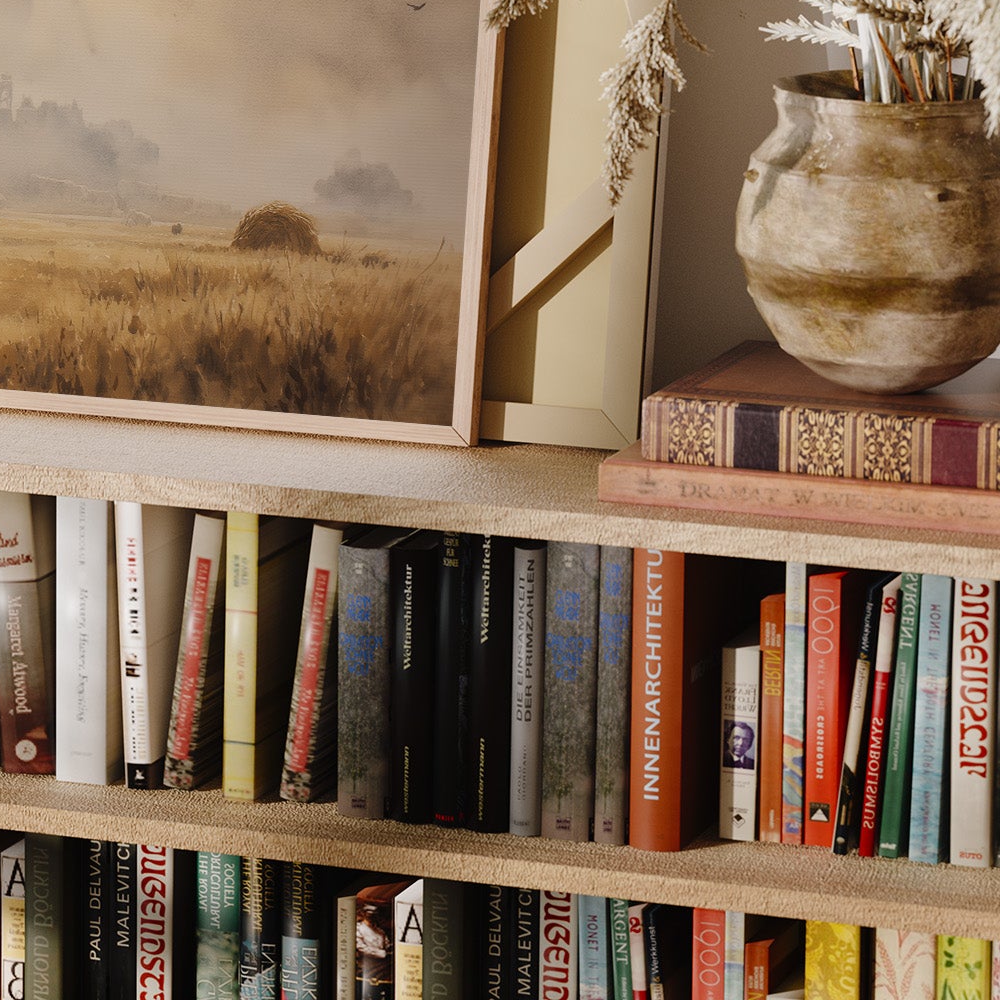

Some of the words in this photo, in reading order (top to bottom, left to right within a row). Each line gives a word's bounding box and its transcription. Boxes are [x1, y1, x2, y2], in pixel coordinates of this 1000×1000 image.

[6, 595, 25, 656] Margaret
[403, 563, 413, 671] Weltarchitektur
[516, 576, 526, 686] EINSAMKEIT
[525, 558, 535, 679] PRIMZAHLEN
[11, 660, 32, 714] Atwood
[524, 684, 533, 722] DER
[643, 549, 663, 801] INNENARCHITEKTU
[516, 693, 524, 722] DIE
[477, 738, 486, 822] westermann
[89, 840, 102, 910] DELVAU
[90, 916, 102, 962] PAUL
[488, 885, 502, 960] DELVAU
[586, 914, 599, 951] MONET
[629, 917, 642, 934] 2
[650, 926, 660, 975] Werkkunst
[693, 921, 721, 987] 1900
